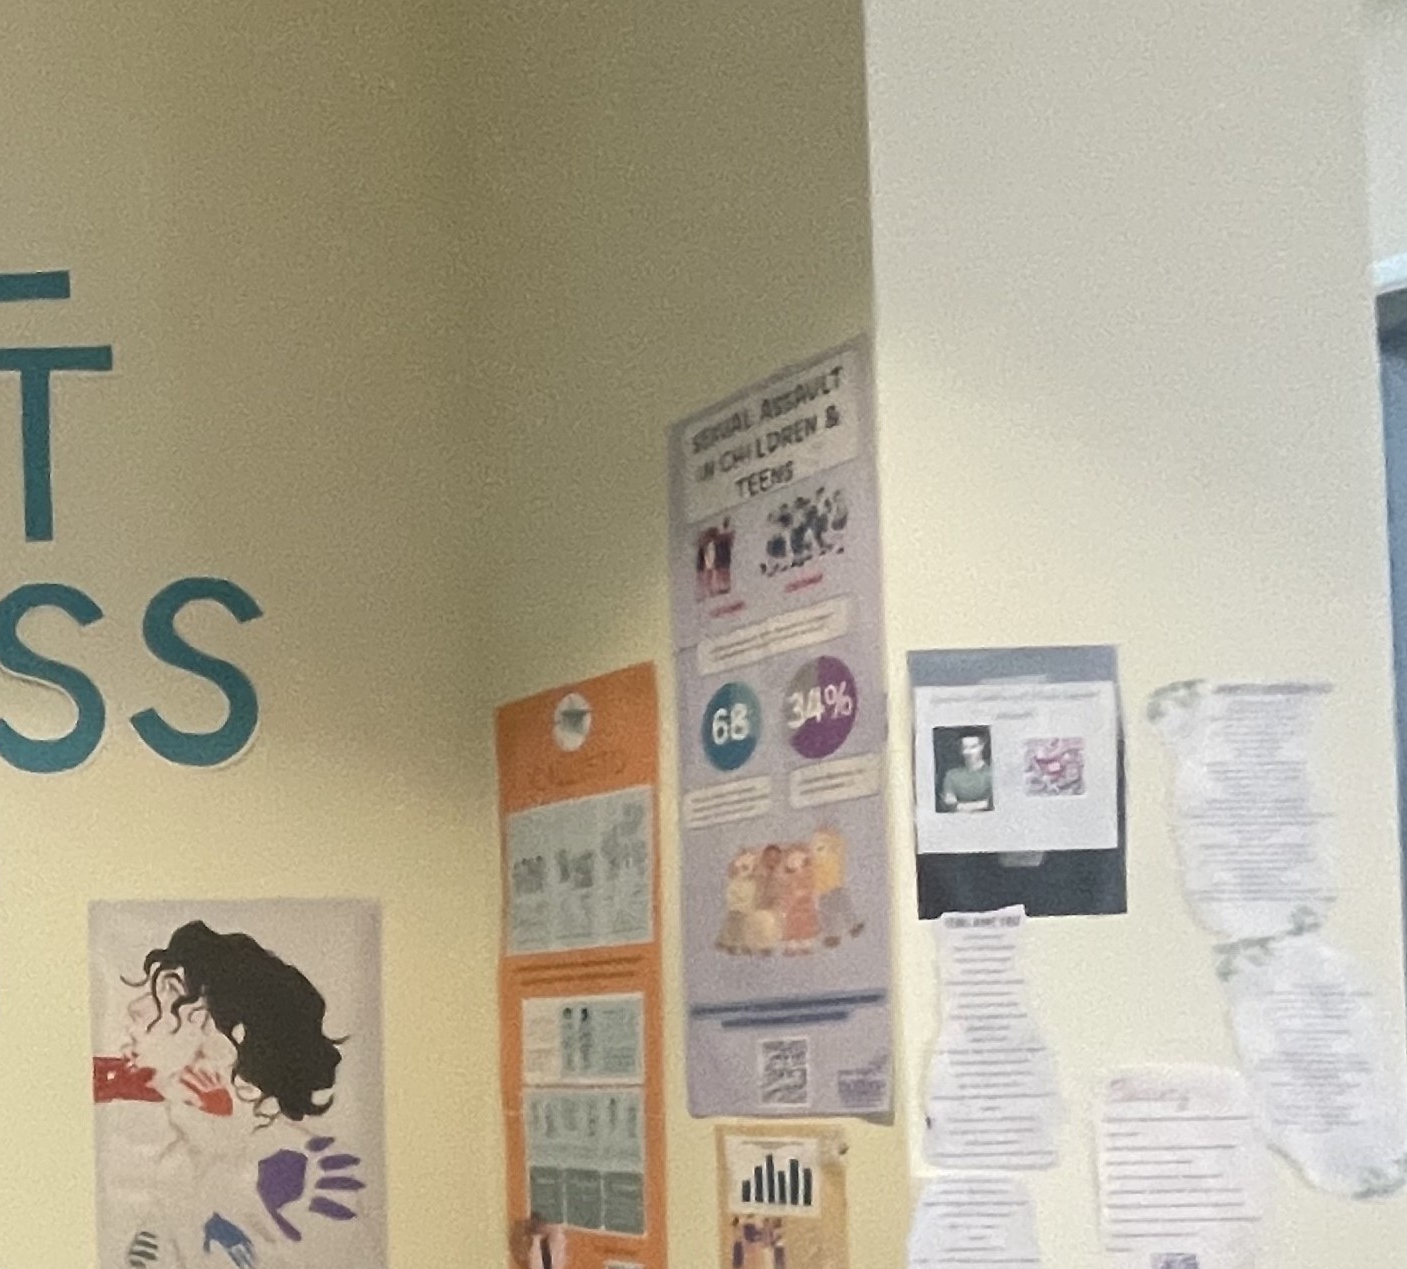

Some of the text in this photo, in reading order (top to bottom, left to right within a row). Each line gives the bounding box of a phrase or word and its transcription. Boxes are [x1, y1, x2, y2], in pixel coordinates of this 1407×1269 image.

[759, 364, 843, 423] ASSAULT
[718, 413, 818, 474] CHILDREN
[734, 459, 795, 500] TEENS
[711, 680, 852, 746] 68 34%
